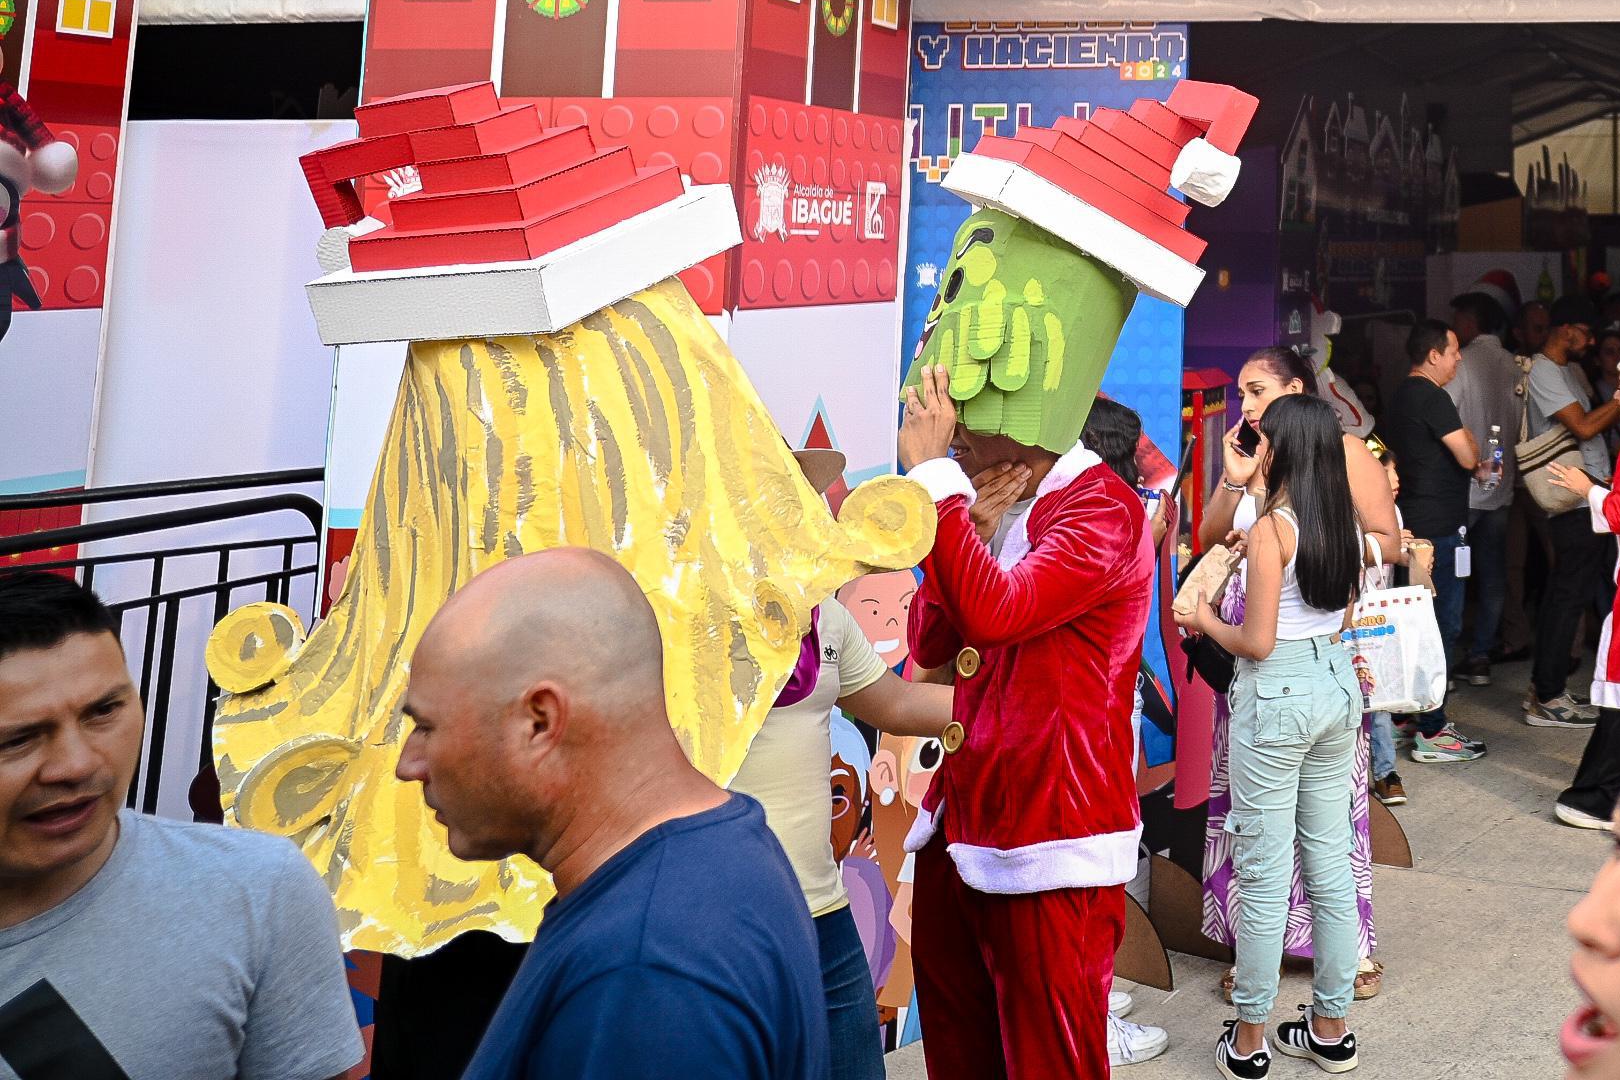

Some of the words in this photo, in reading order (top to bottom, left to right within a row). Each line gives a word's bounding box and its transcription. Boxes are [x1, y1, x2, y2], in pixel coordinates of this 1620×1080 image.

[918, 34, 949, 69] Y
[964, 32, 1186, 67] HACIENDO
[1124, 65, 1182, 78] 2024
[824, 185, 834, 198] de
[791, 194, 853, 226] IBAGUÉ
